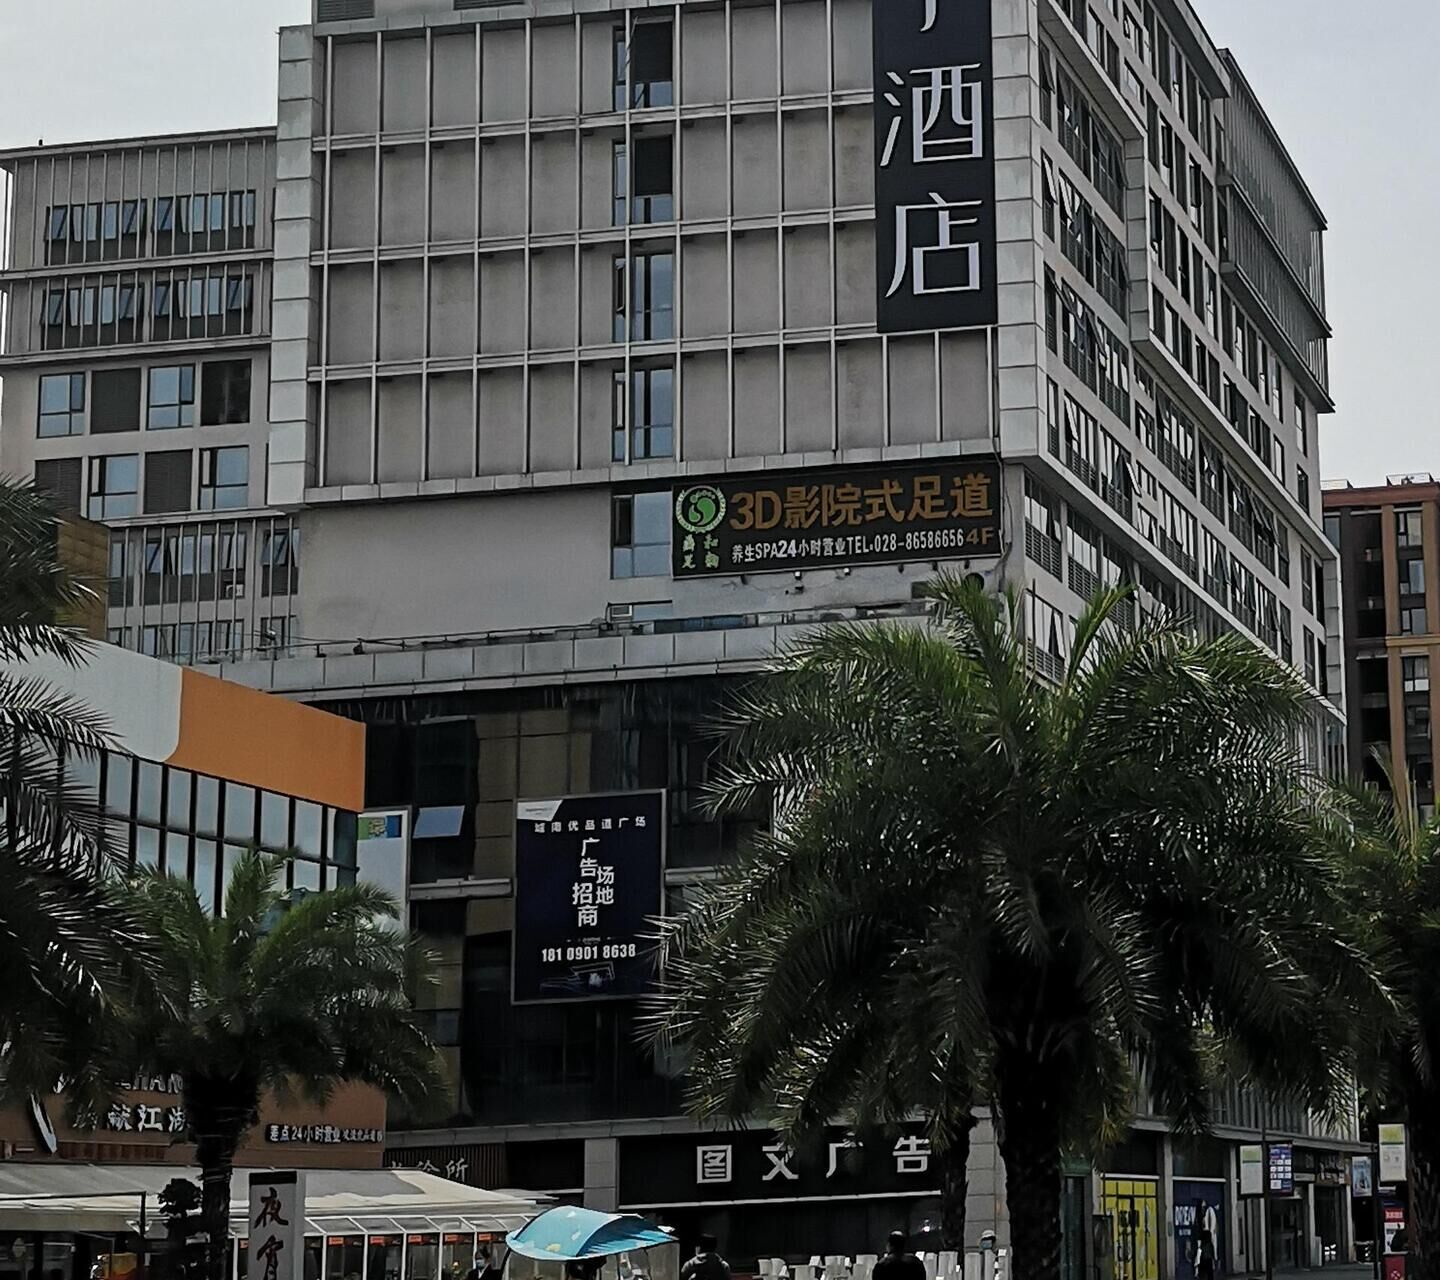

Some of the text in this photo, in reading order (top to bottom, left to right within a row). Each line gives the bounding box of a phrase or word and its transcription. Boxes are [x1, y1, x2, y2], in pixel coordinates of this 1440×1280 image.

[729, 472, 993, 531] 3D影院式足道
[965, 527, 994, 545] 4F
[541, 943, 635, 962] 181 0901 8638
[696, 1135, 932, 1184] 图文广告
